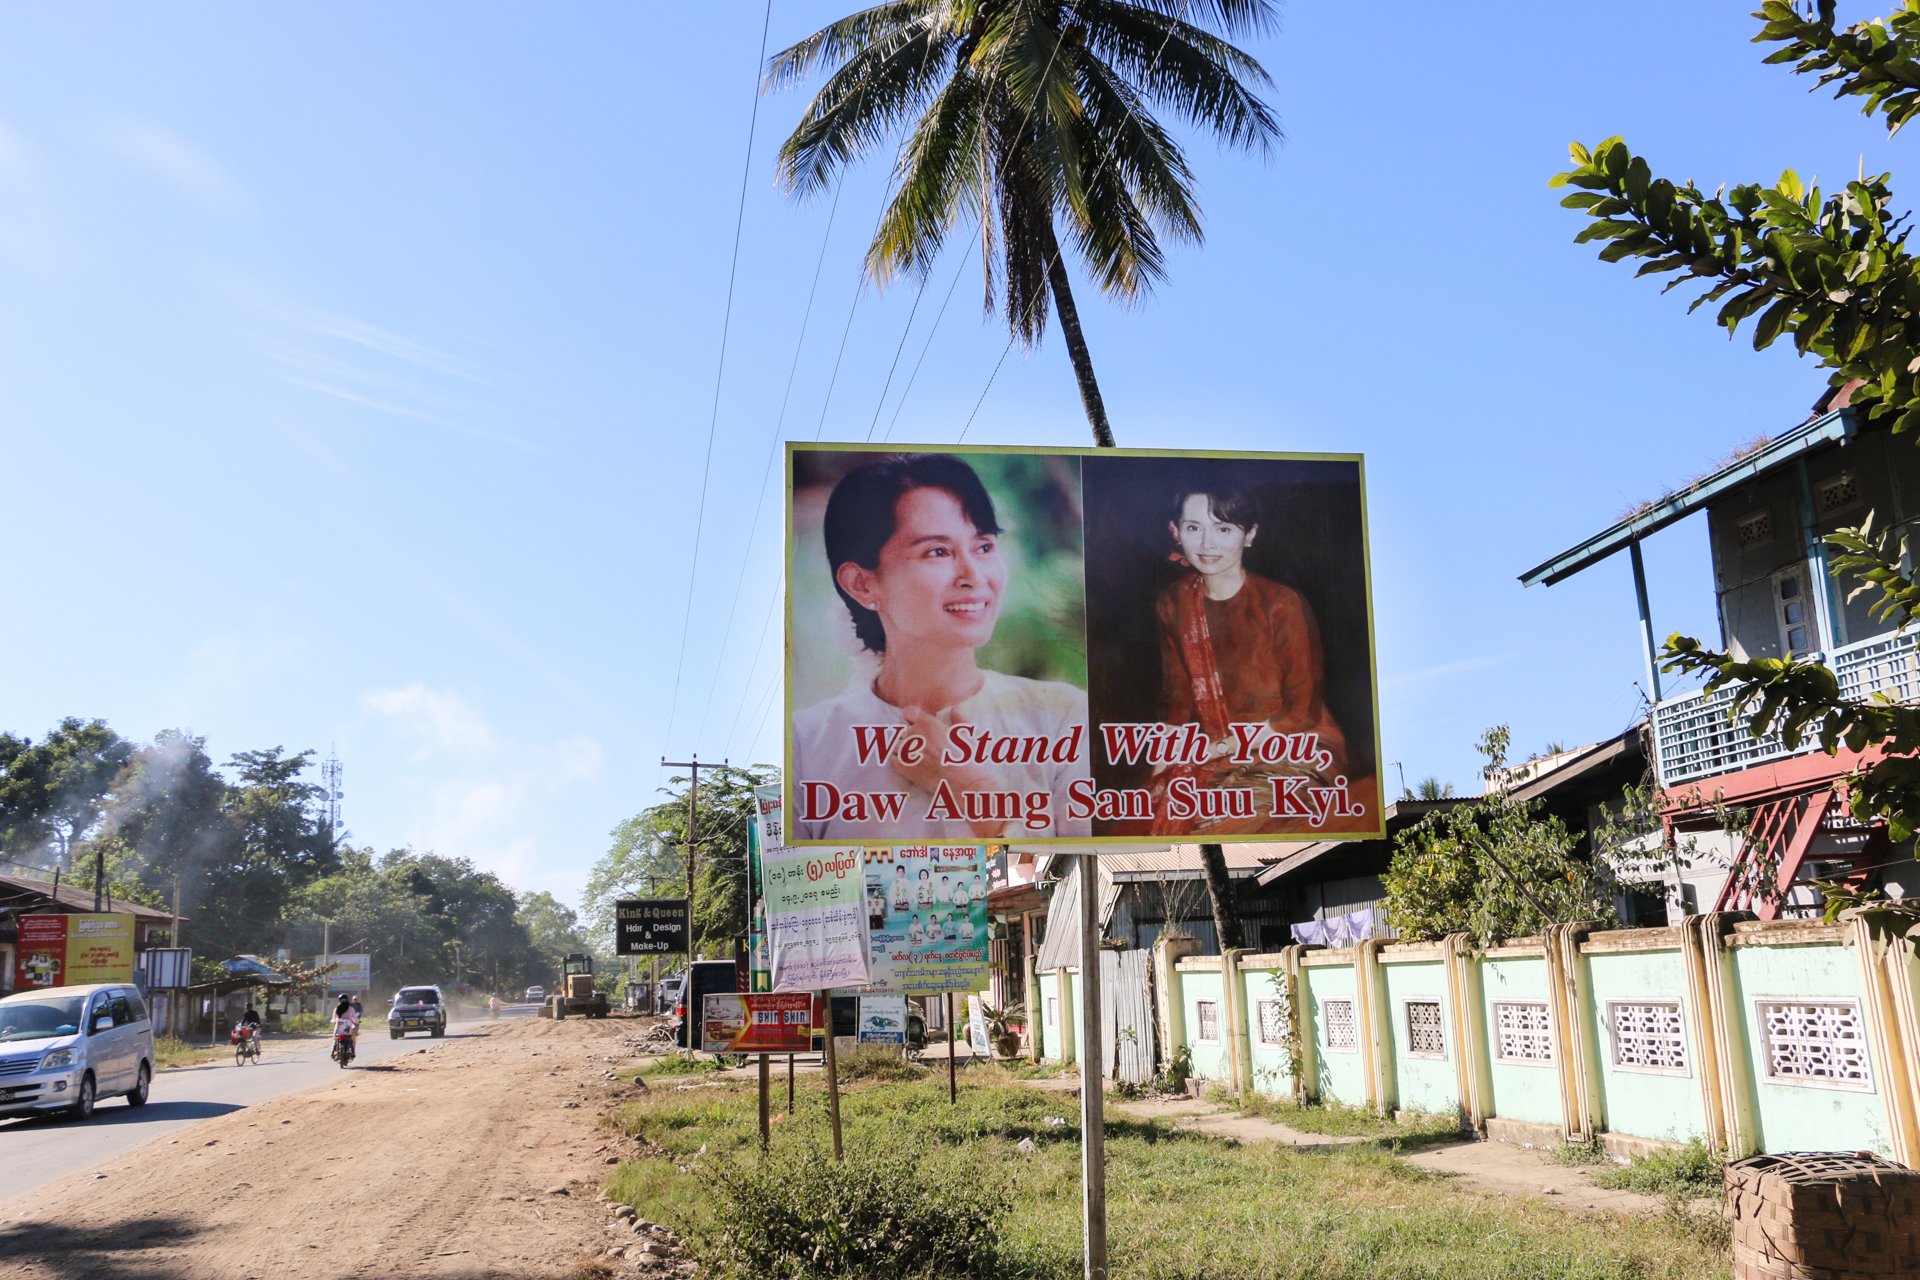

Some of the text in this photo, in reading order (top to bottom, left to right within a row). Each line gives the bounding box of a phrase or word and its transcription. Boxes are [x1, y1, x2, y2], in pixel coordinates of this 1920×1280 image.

[852, 723, 1332, 771] We Stand With You,
[801, 775, 1365, 830] Daw Aung San Suu Kyi.
[618, 907, 684, 918] King & Queen
[626, 923, 682, 933] Hair Design
[644, 930, 652, 940] &
[630, 941, 669, 951] Make-Up
